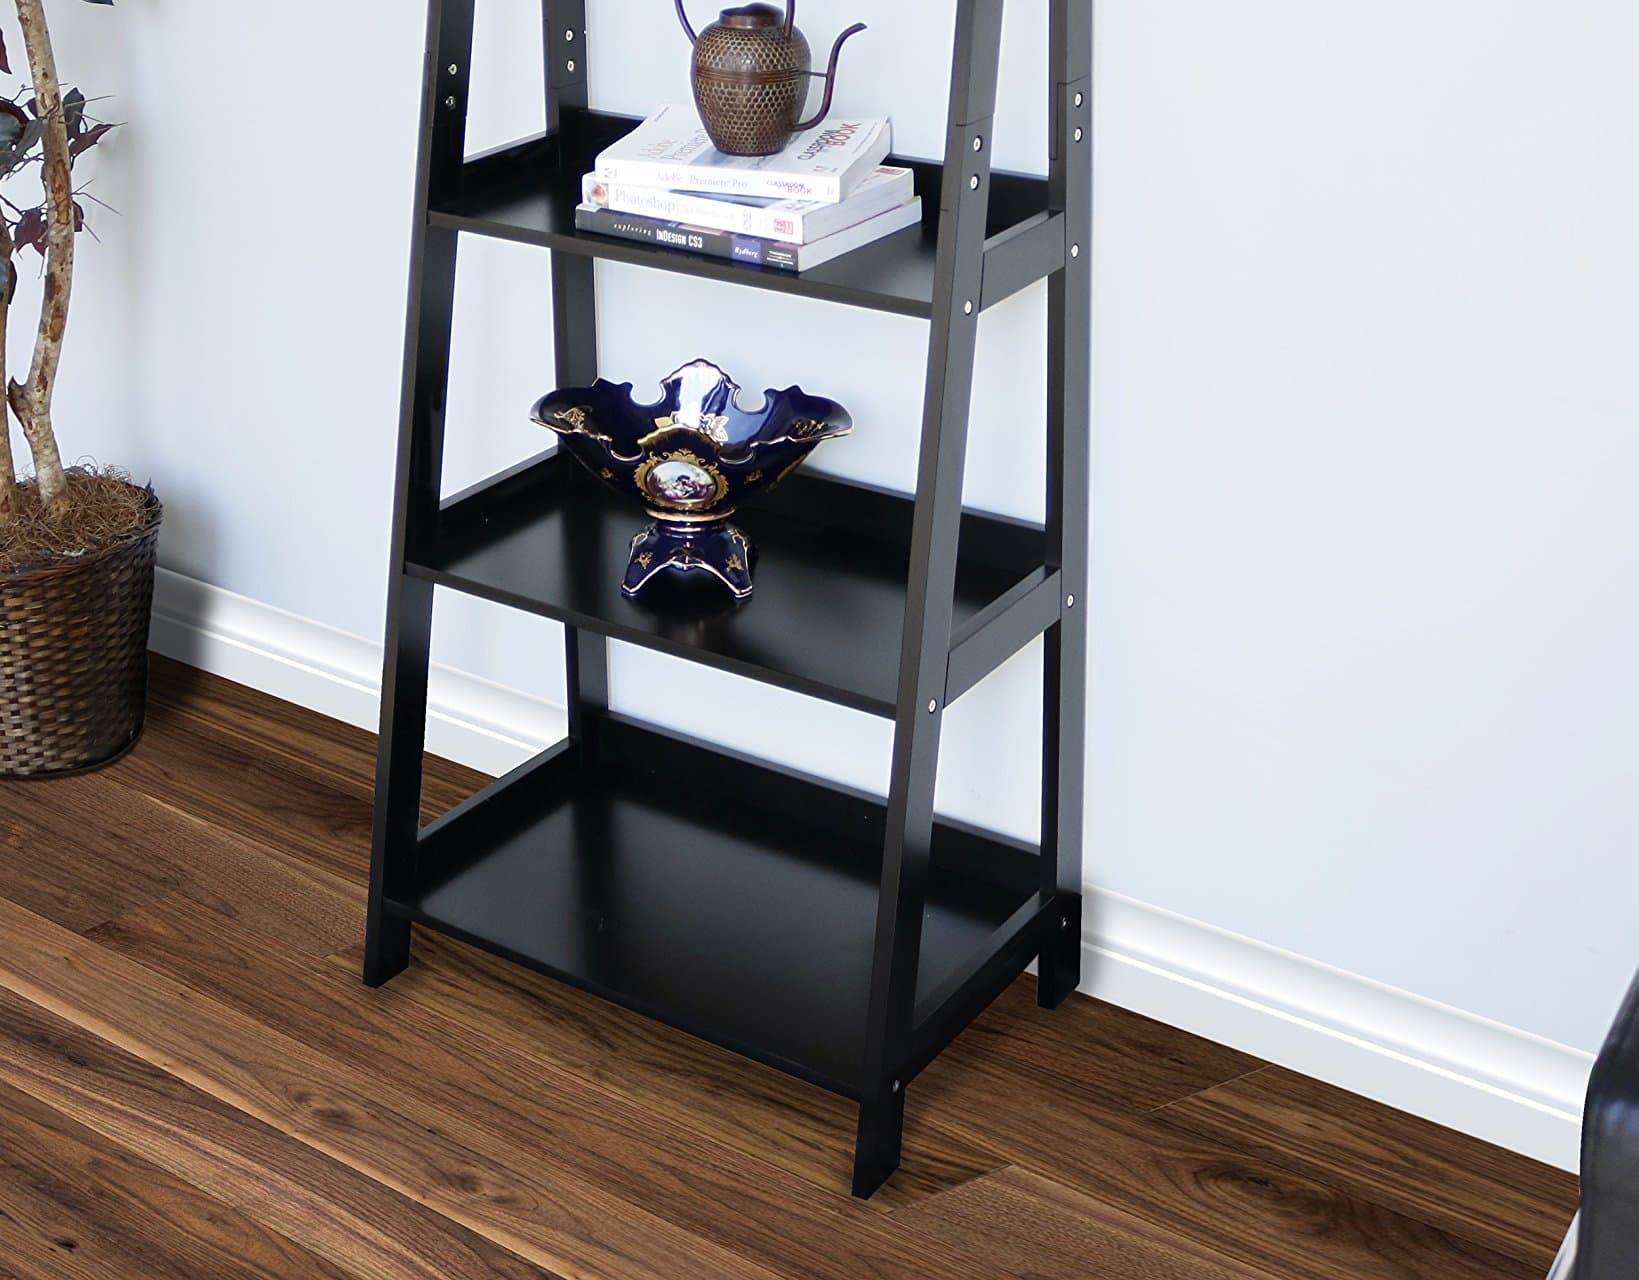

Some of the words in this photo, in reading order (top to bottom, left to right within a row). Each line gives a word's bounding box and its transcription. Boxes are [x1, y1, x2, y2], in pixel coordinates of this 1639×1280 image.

[827, 122, 862, 146] BOOK
[731, 179, 748, 189] Pro
[787, 185, 812, 195] BOOK
[614, 188, 676, 215] Photoshop
[614, 223, 652, 236] exploring
[688, 235, 703, 249] CS3
[734, 246, 759, 259] Rydberg
